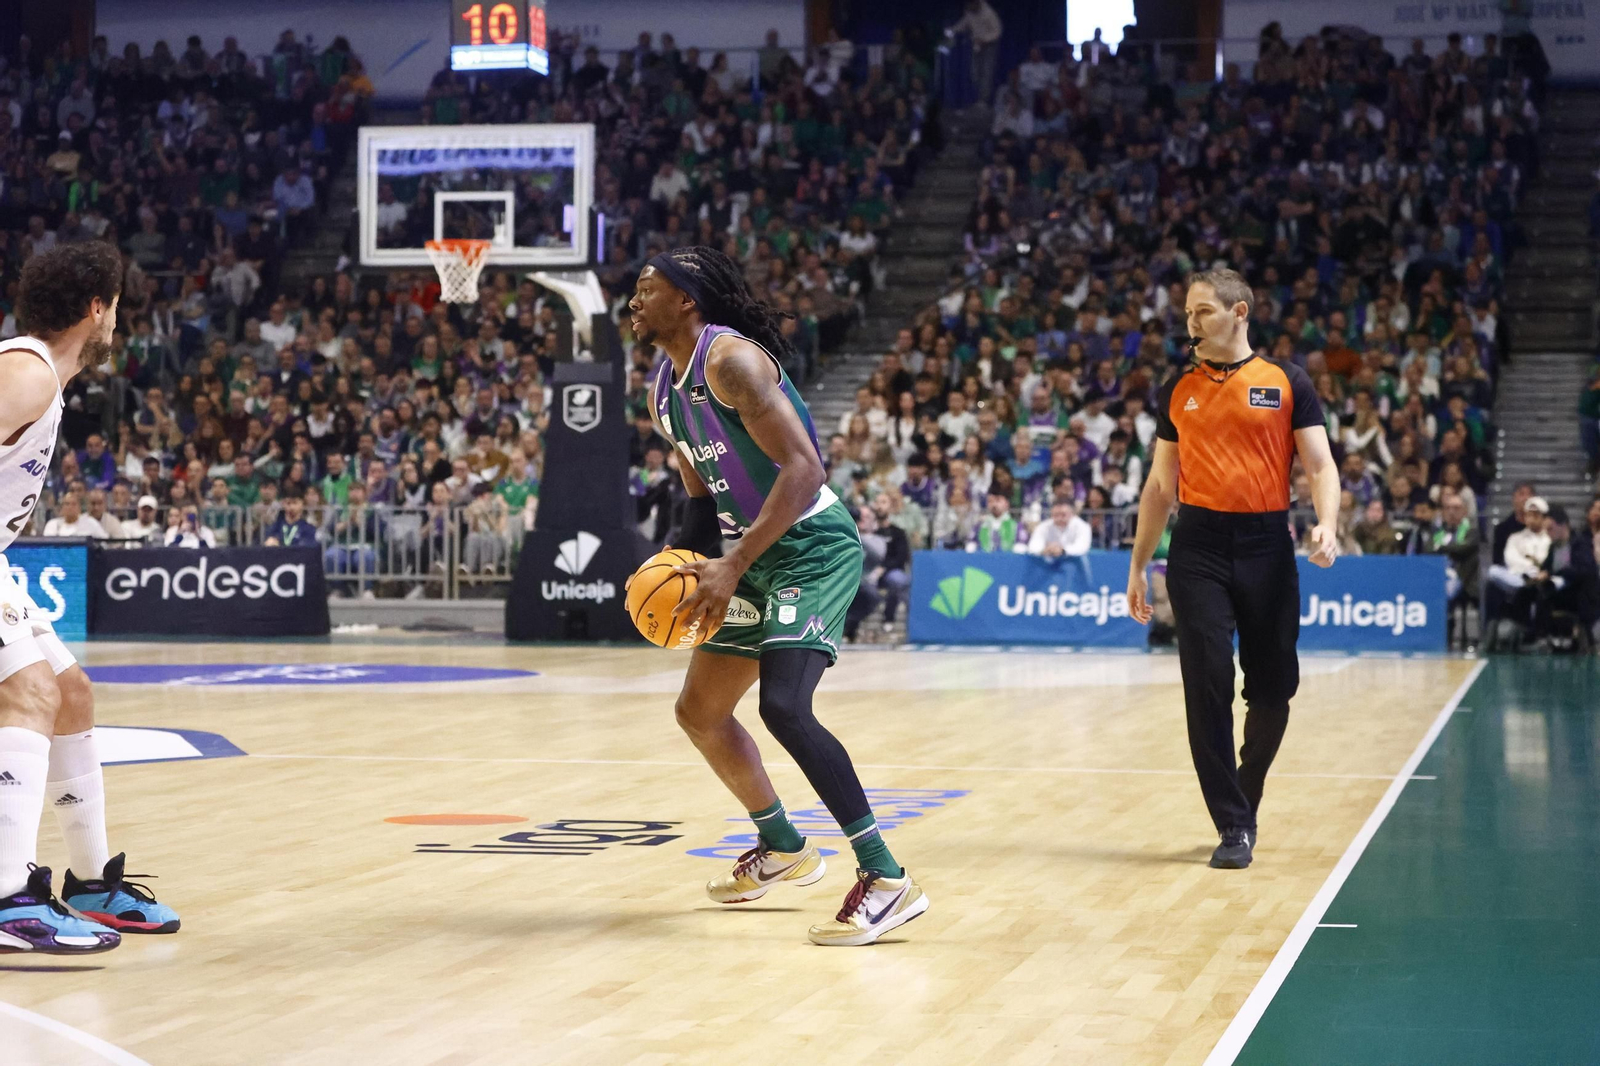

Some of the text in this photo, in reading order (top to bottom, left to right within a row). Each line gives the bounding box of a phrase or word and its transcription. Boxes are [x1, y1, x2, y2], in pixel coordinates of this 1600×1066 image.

[462, 4, 518, 46] 10
[105, 556, 305, 600] endesa
[541, 579, 616, 604] Unicaja
[780, 591, 795, 599] acb
[998, 584, 1129, 626] Unicaja
